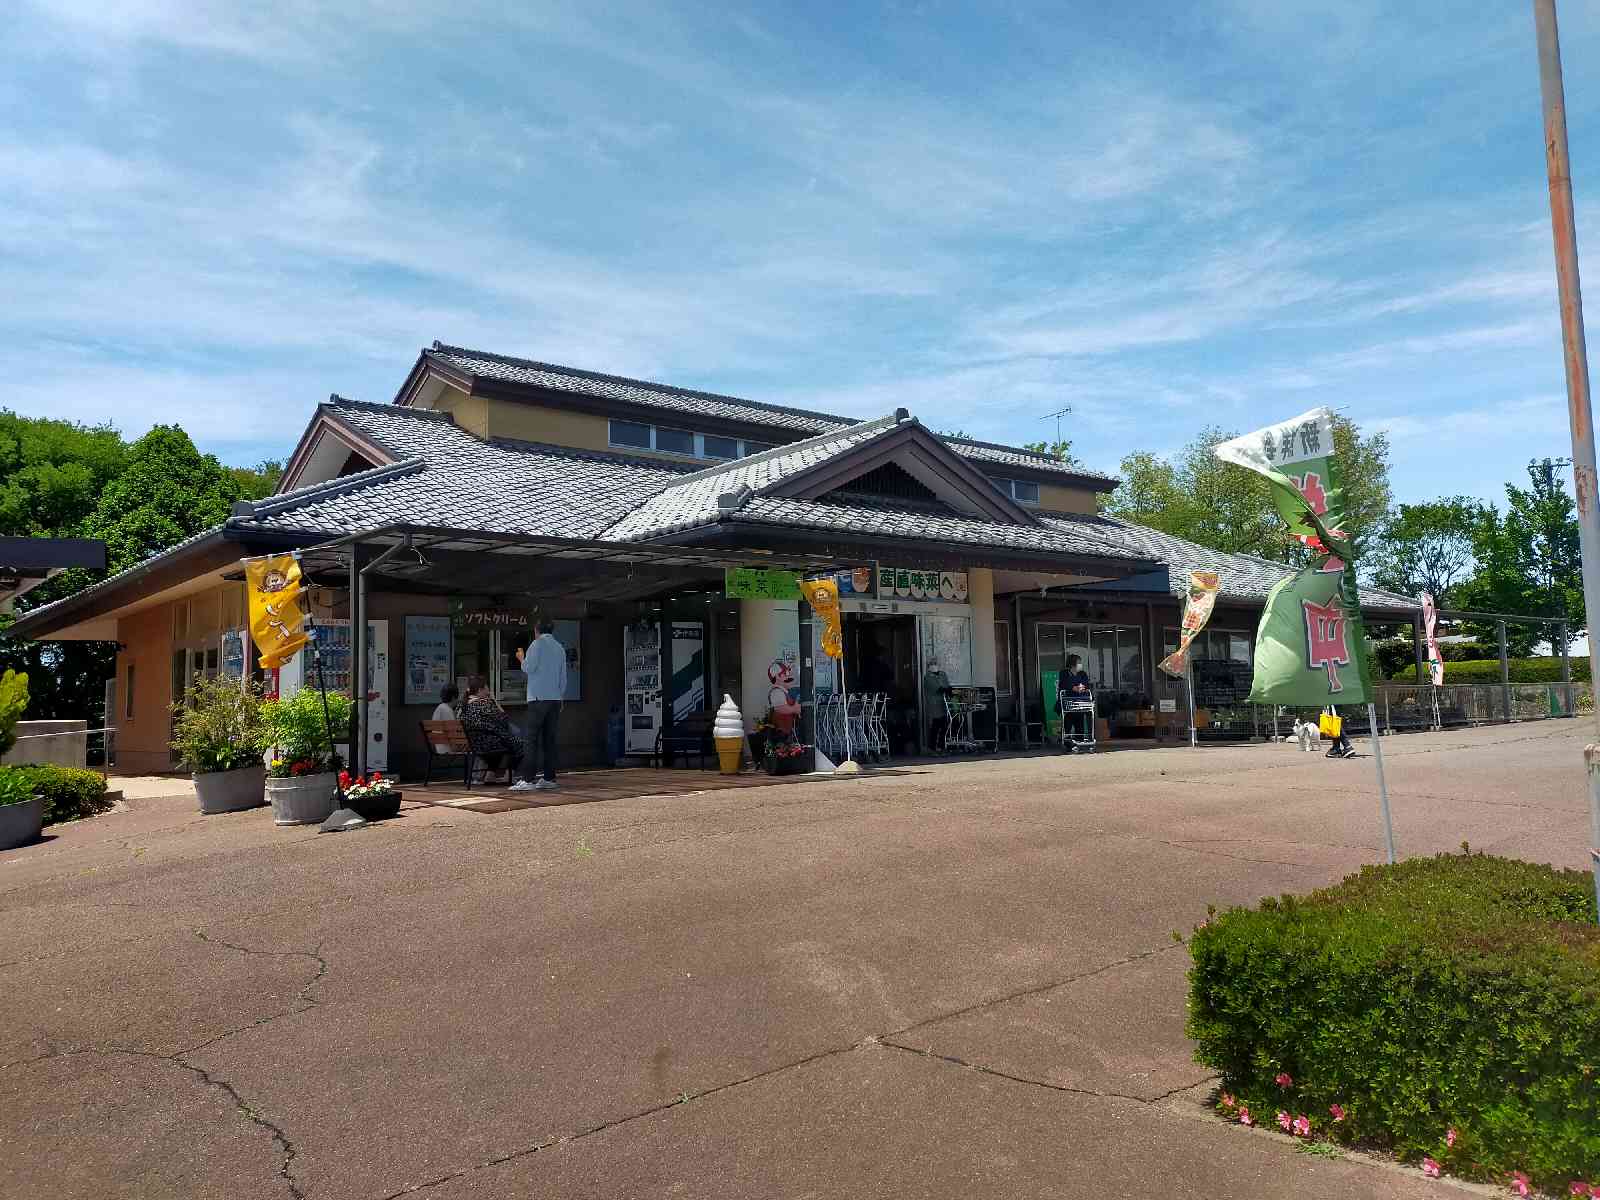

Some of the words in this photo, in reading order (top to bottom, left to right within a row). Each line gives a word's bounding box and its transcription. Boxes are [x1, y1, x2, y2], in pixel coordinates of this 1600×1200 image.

[465, 612, 528, 625] ソフトクリーム
